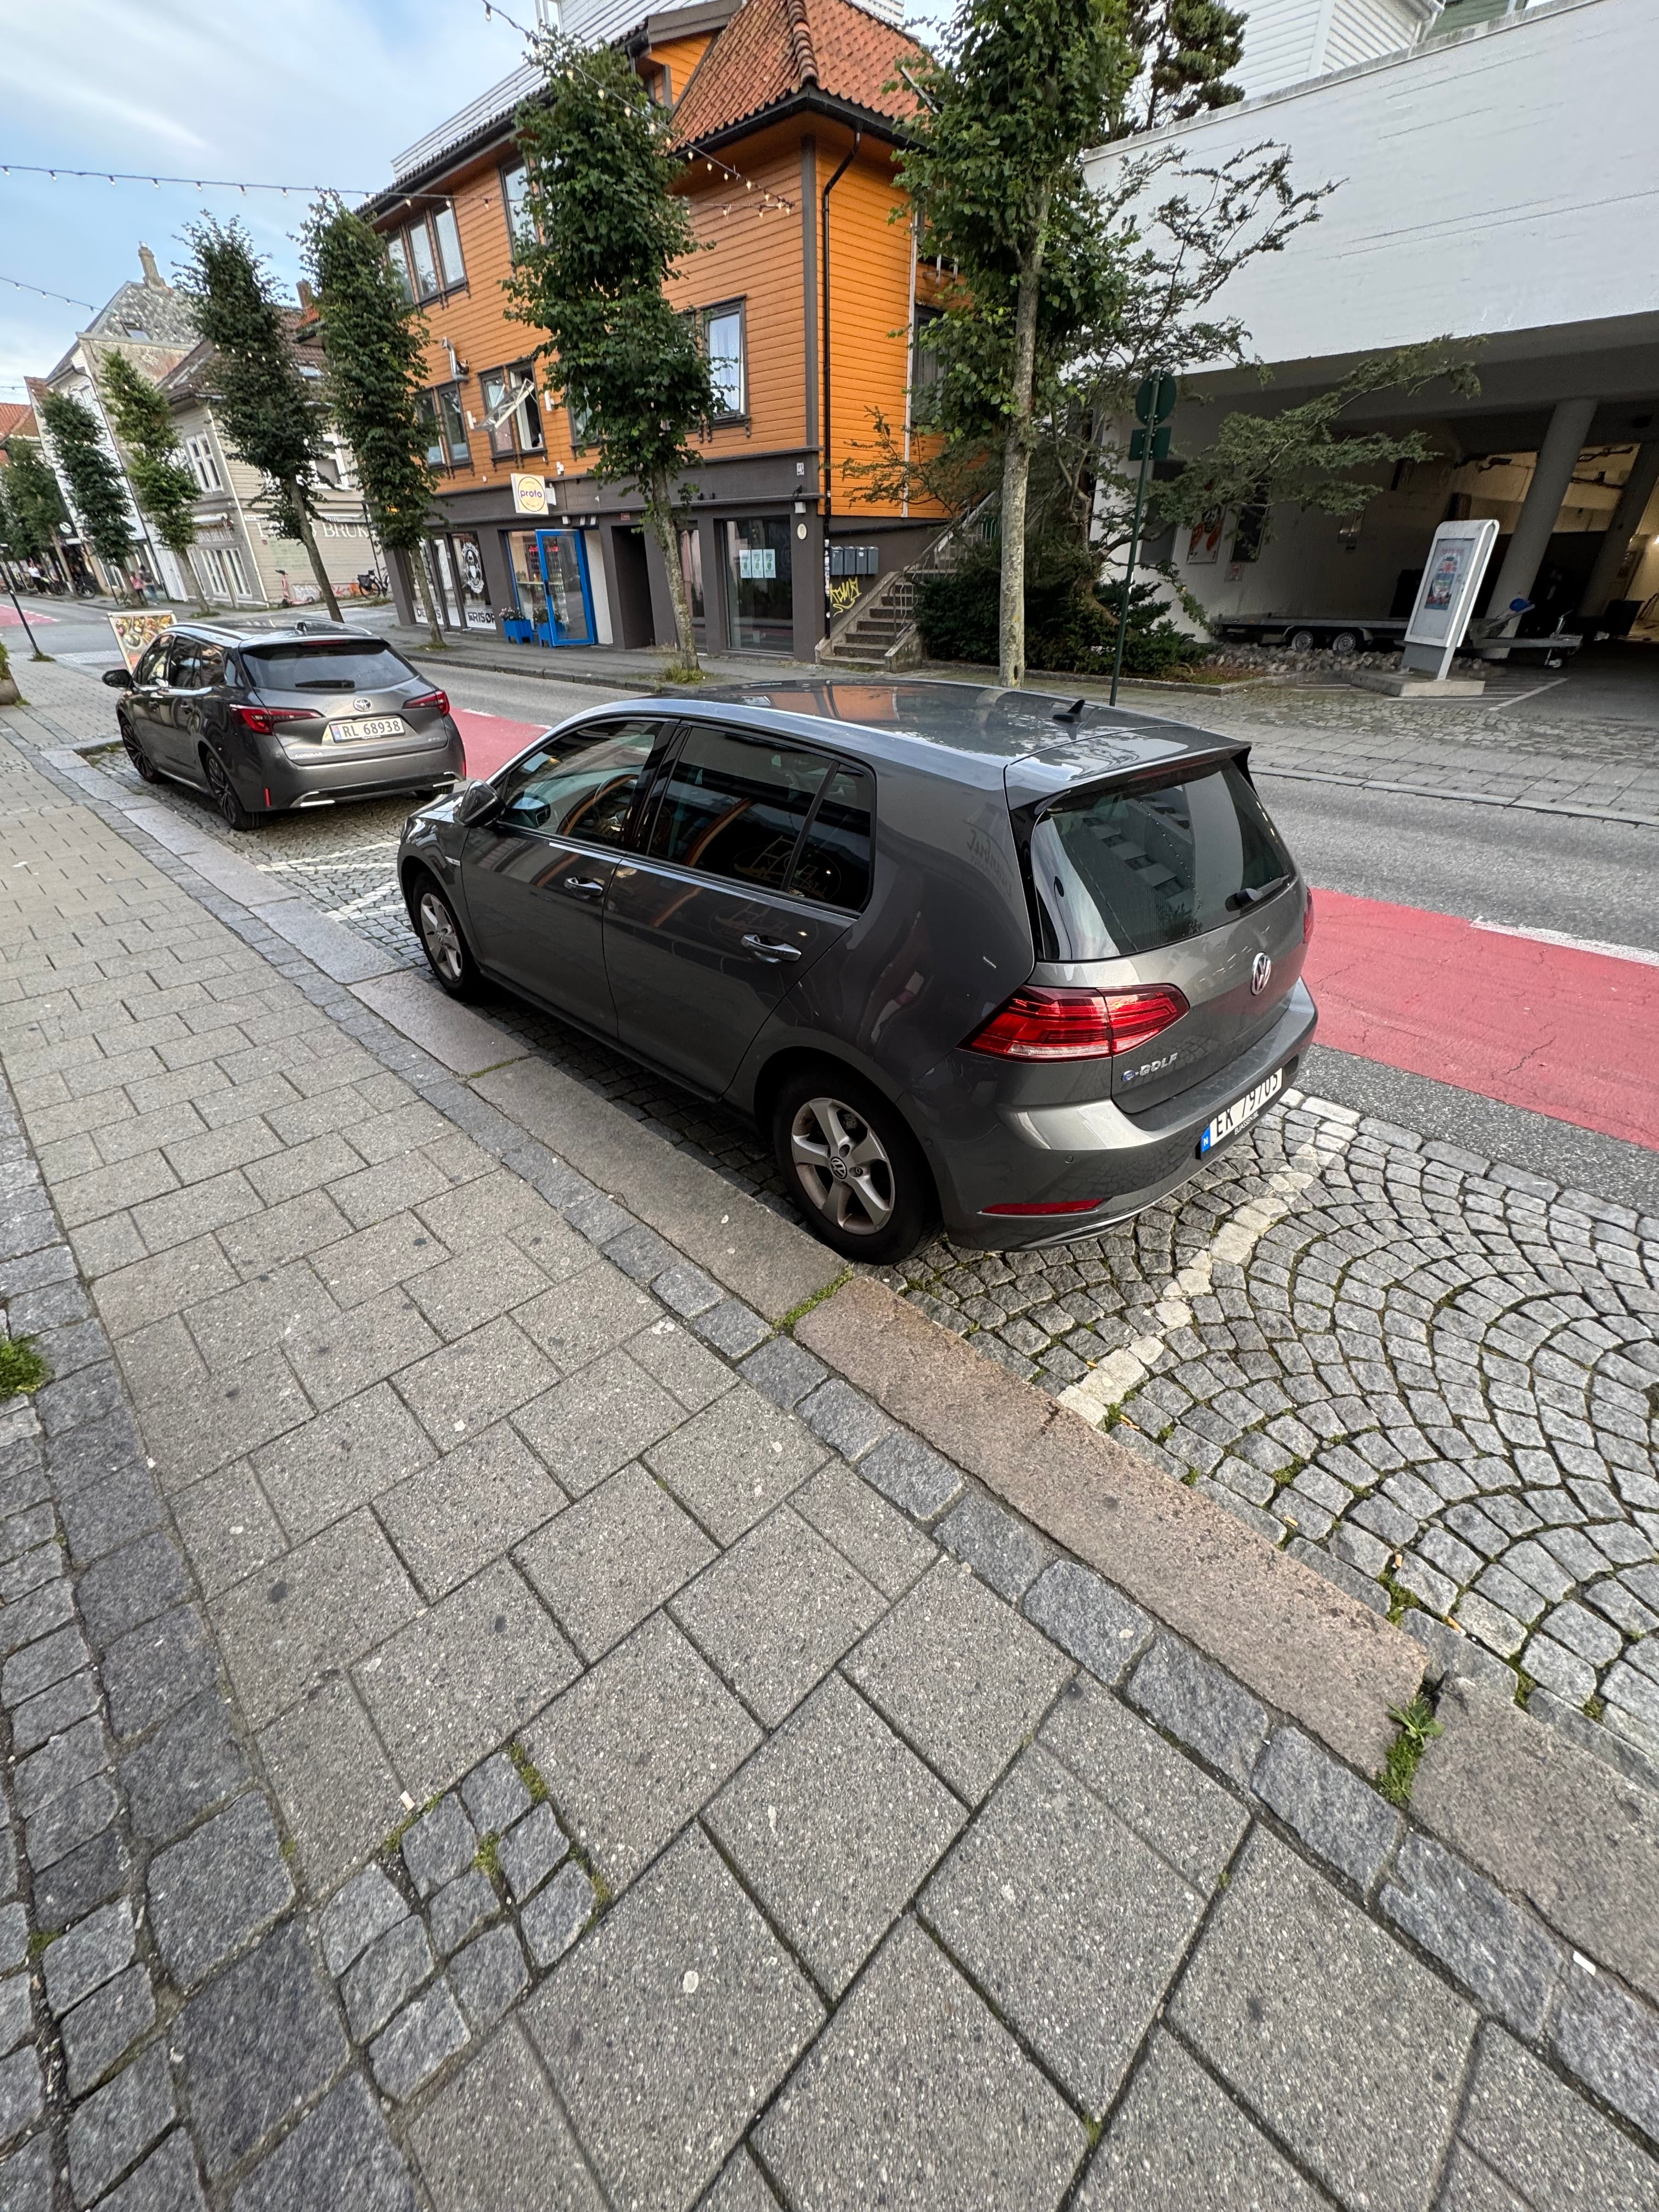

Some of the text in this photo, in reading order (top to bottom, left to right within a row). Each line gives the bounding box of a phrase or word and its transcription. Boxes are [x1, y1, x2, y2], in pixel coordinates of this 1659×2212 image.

[520, 489, 542, 498] proto
[342, 720, 400, 737] RL 68938
[1216, 1108, 1233, 1137] EK
